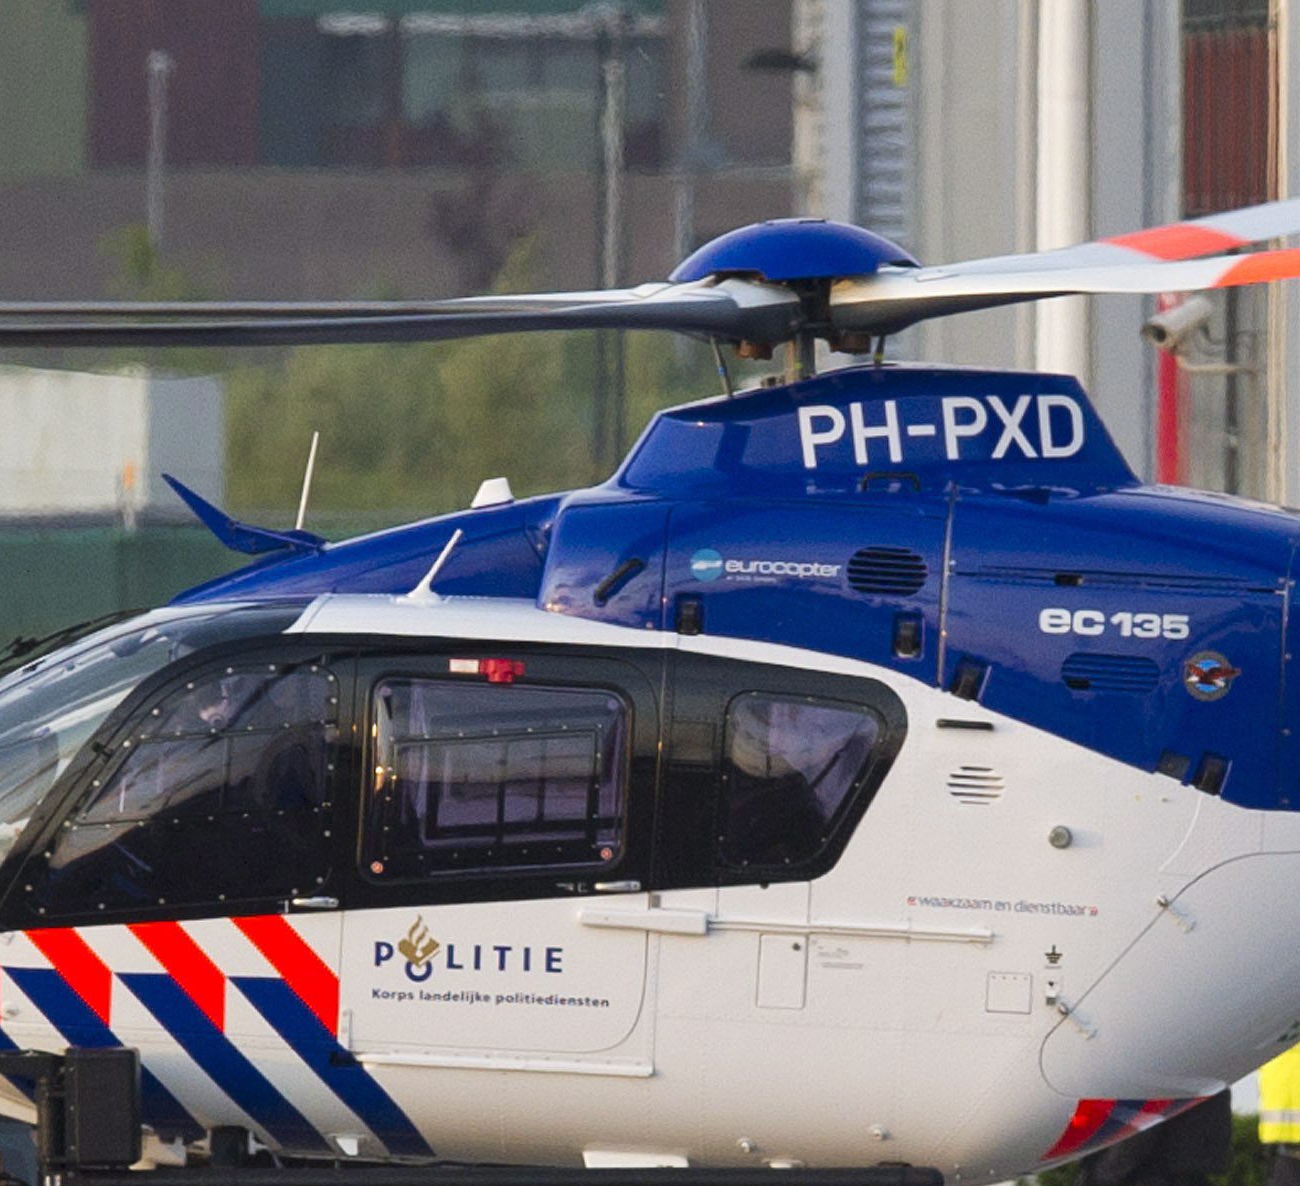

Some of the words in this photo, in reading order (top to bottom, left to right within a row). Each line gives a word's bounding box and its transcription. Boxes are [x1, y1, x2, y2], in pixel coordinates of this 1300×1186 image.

[798, 394, 1084, 469] PH-PXD
[725, 559, 841, 578] eurocopter
[1110, 612, 1190, 640] 135
[918, 896, 992, 910] waakzaam
[994, 899, 1012, 912] en
[1013, 899, 1087, 916] dienstbaar
[373, 939, 564, 983] POLITIE
[371, 988, 414, 1002] Korps
[419, 989, 491, 1005] landelijke
[495, 992, 610, 1008] politiediensten
